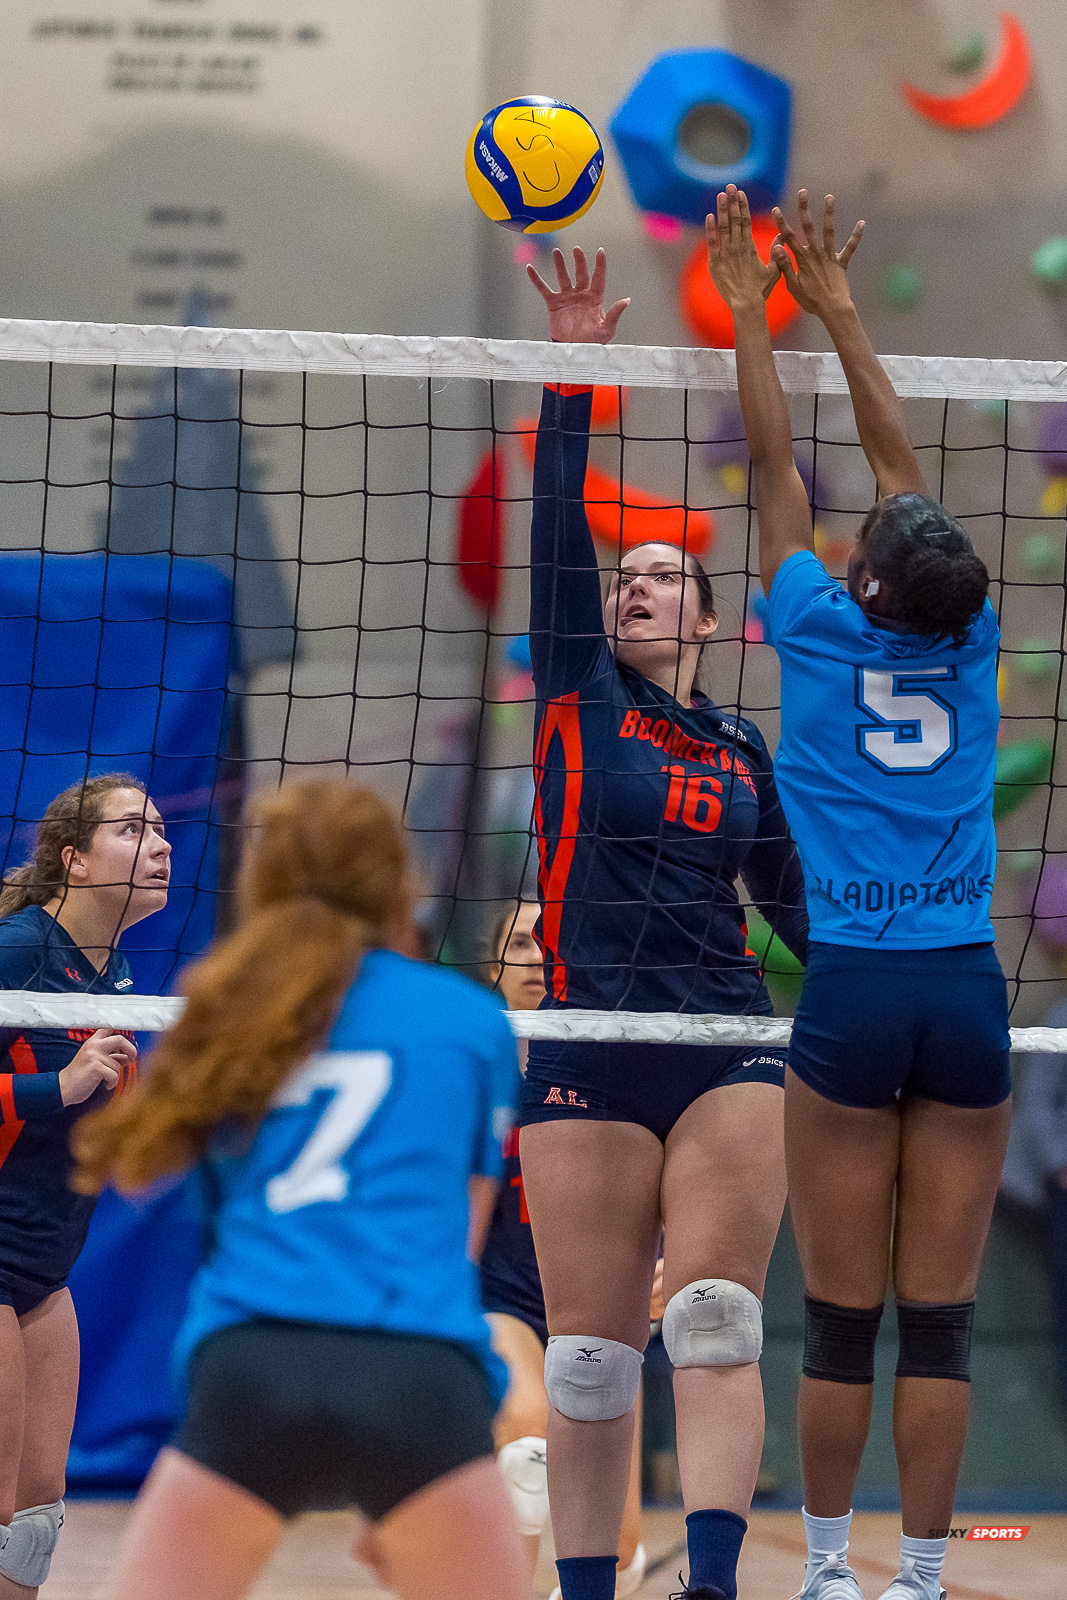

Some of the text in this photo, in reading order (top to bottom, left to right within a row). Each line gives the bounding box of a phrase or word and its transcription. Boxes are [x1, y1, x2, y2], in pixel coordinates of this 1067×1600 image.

[854, 665, 958, 777] 5
[661, 764, 724, 833] 16
[266, 1050, 394, 1214] 7
